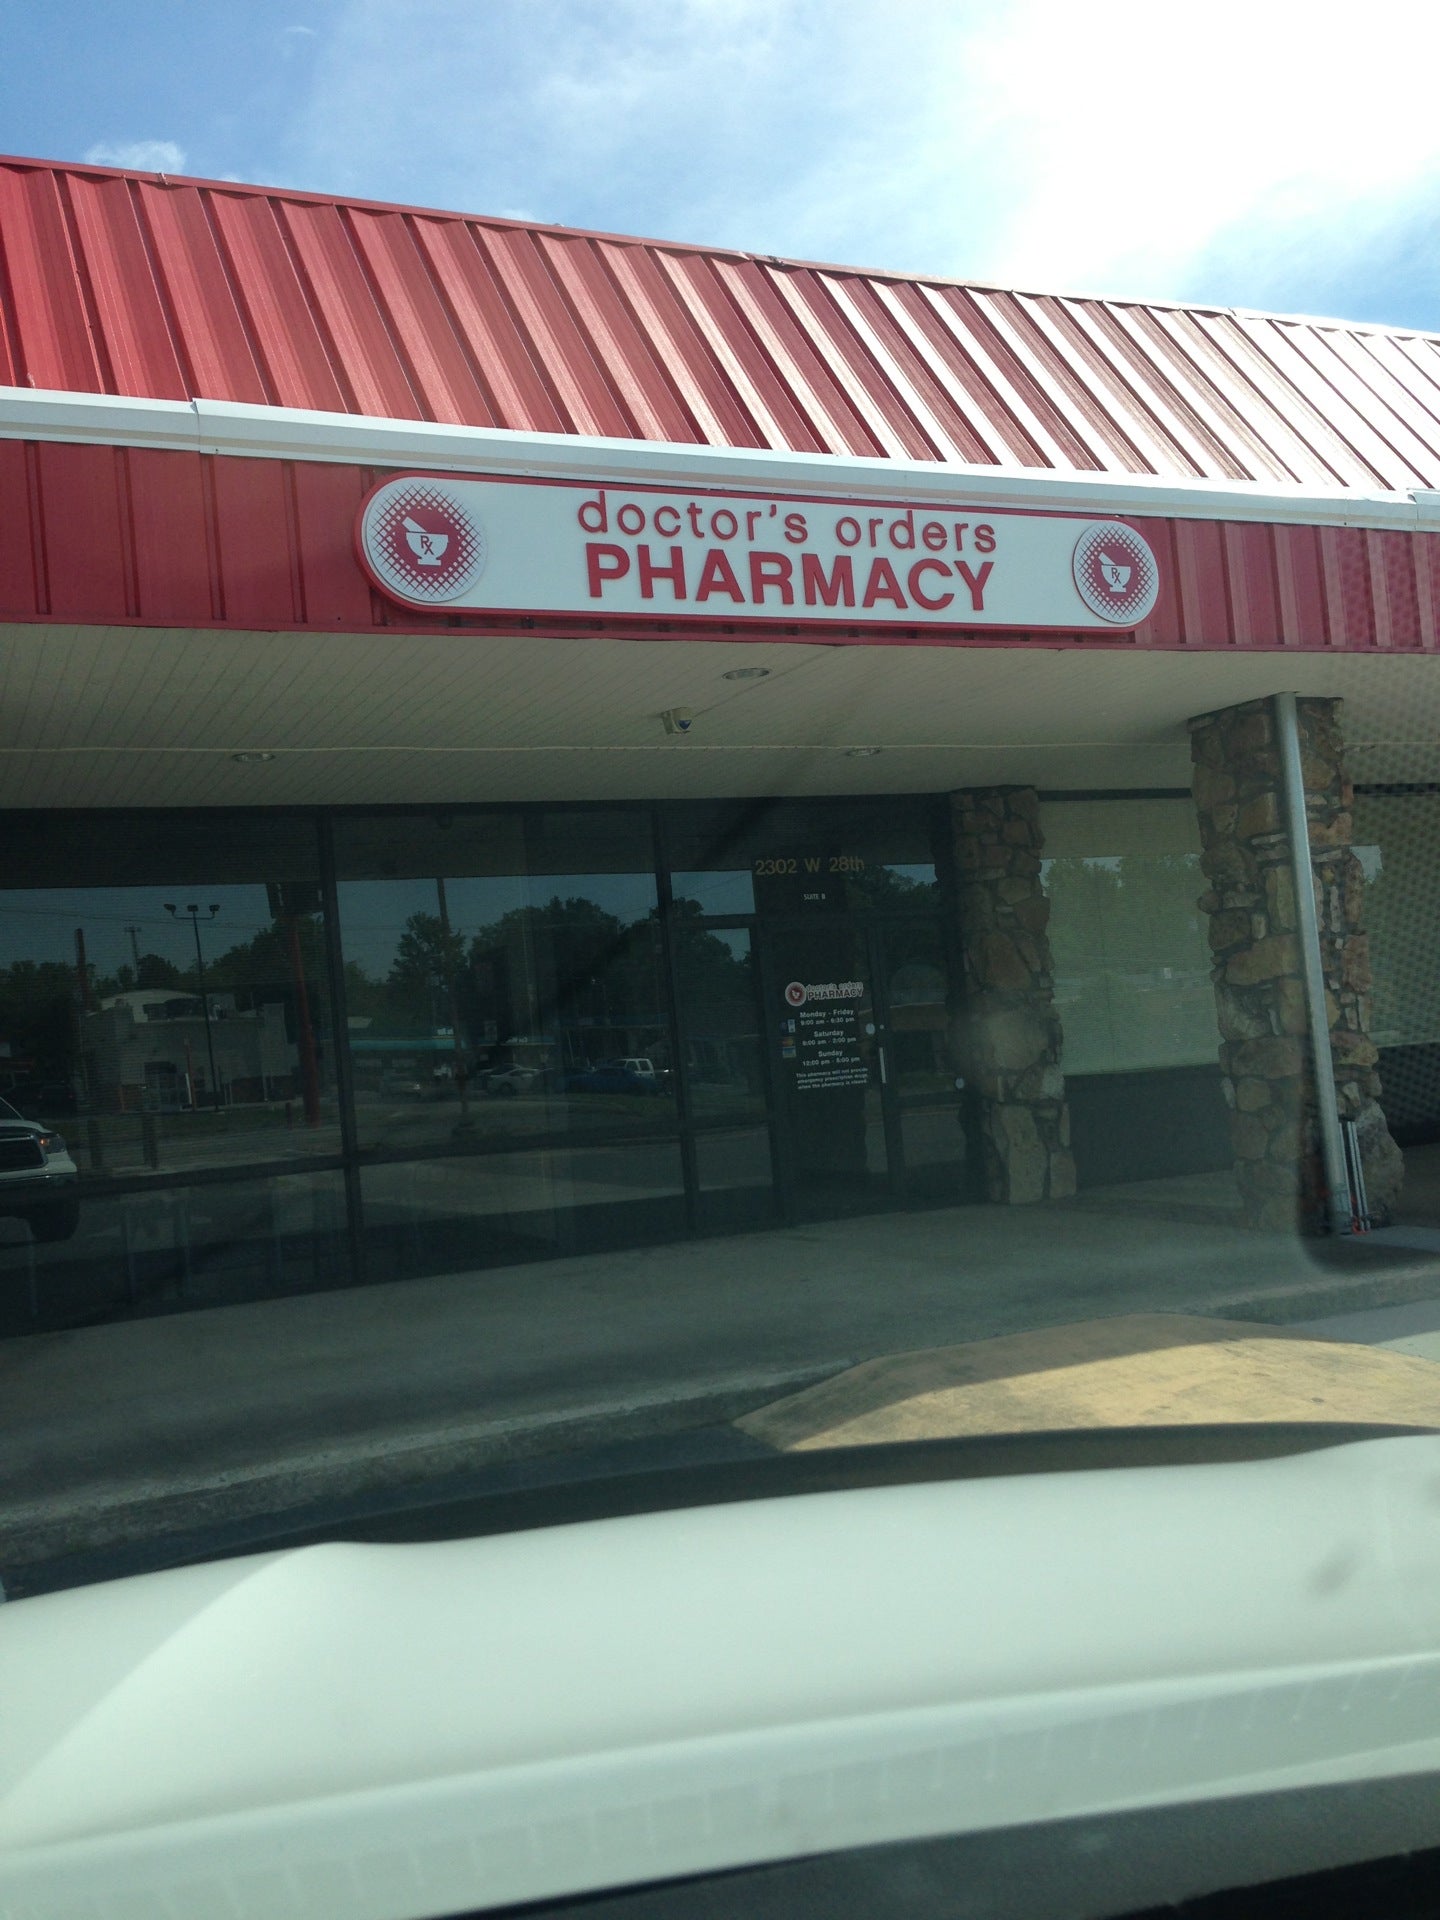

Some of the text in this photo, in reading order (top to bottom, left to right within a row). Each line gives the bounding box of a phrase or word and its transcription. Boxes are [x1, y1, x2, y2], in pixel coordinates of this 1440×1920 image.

[578, 490, 996, 553] doctor's orders
[585, 542, 995, 611] PHARMACY
[755, 855, 865, 876] 2302 W 28th
[803, 893, 819, 901] SUITE
[808, 988, 863, 1000] PHARMACY
[814, 1030, 844, 1038] Saturday
[818, 1050, 843, 1058] Sunday
